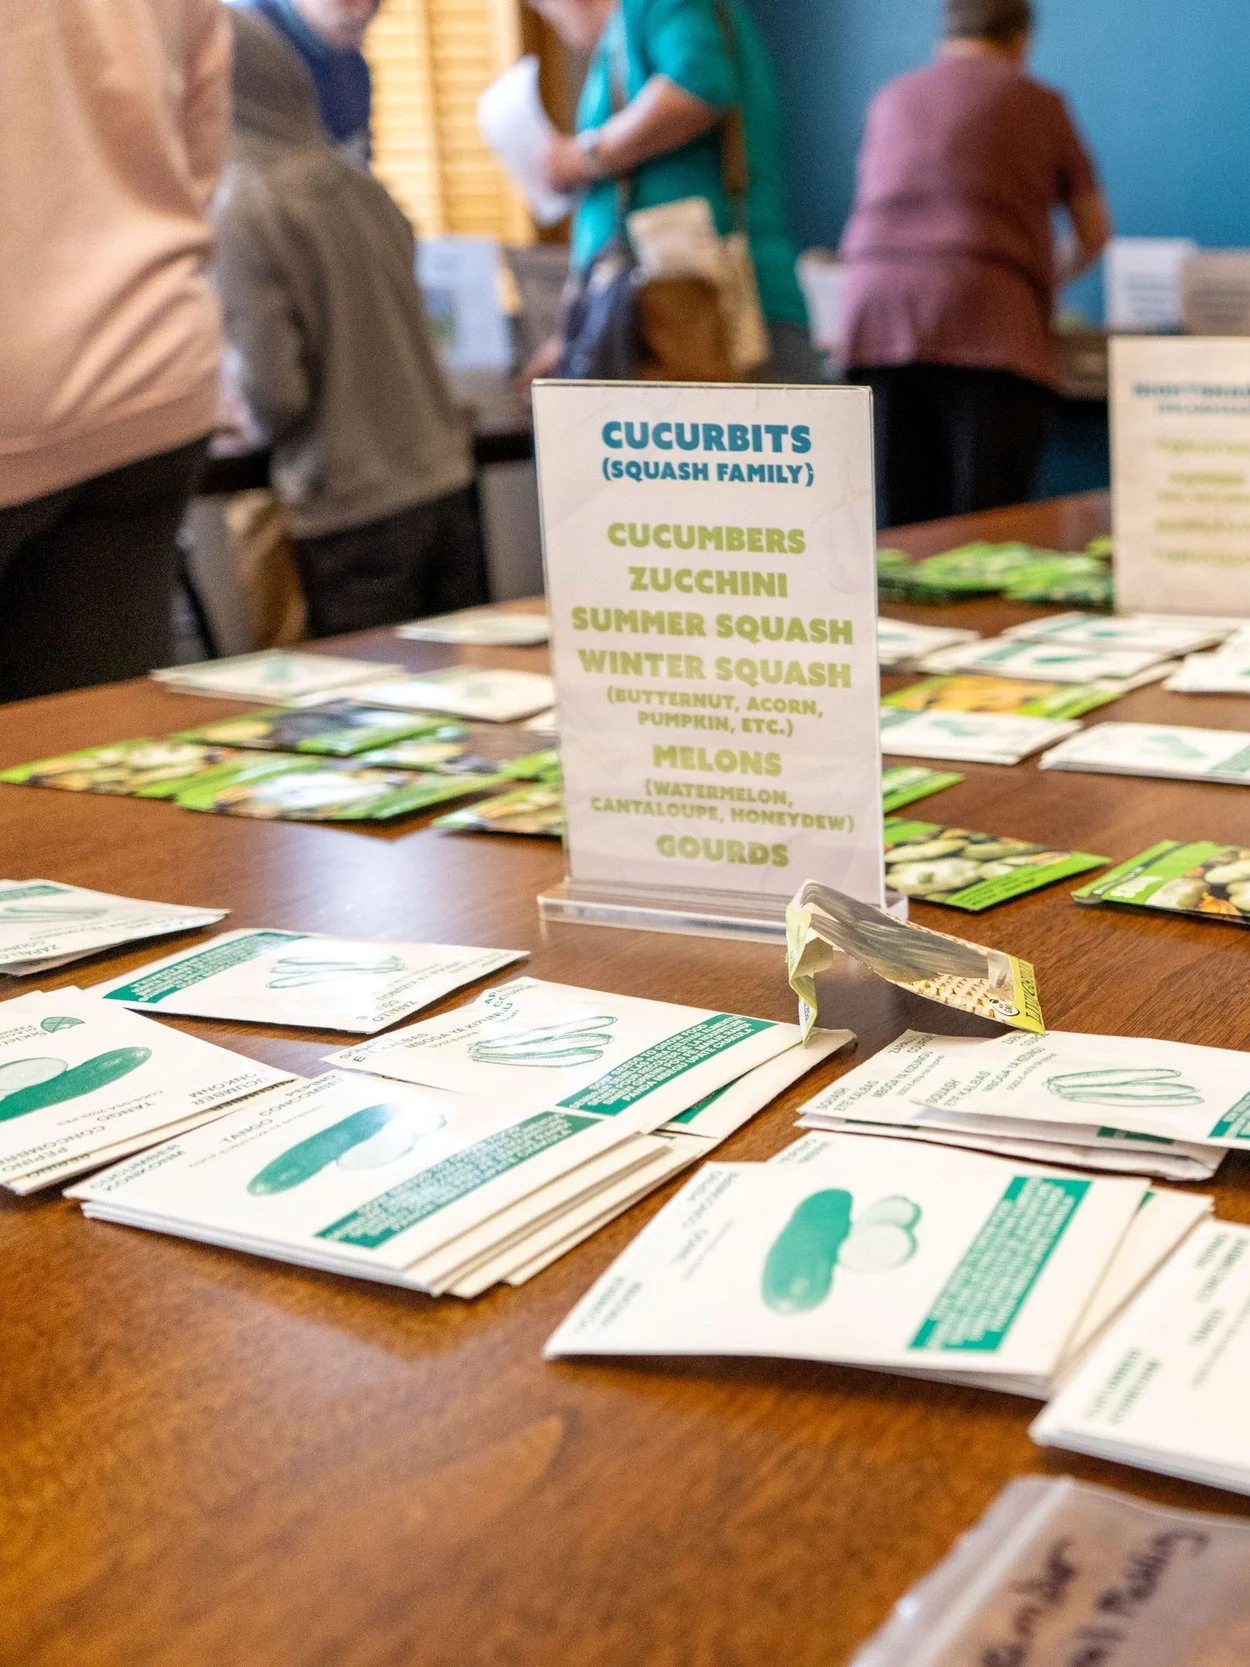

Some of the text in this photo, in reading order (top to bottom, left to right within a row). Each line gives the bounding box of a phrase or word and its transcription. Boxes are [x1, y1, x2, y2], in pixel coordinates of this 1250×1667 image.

[602, 421, 812, 454] CUCURBITS
[602, 457, 814, 487] (SQUASH FAMILY)
[607, 522, 806, 554] CUCUMBERS
[629, 566, 788, 598] ZUCCHINI
[571, 607, 853, 645] SUMMER SQUASH
[577, 649, 852, 688] WINTER SQUASH
[607, 686, 824, 718] (BUTTERNUT, ACORN,
[637, 711, 794, 737] PUMPKIN, ETC.)
[652, 744, 782, 776] MELONS
[645, 778, 793, 807] (WATERMELON,
[591, 796, 855, 834] CANTALOUPE, HONEYDEW)
[656, 835, 789, 868] GOURDS
[189, 1073, 258, 1099] ONKONM
[192, 1077, 269, 1106] UCUMBER
[925, 1079, 961, 1104] SQUASH
[97, 1102, 155, 1122] TANGO
[0, 1125, 105, 1166] CONCOMBR
[2, 1147, 68, 1172] PEPINO
